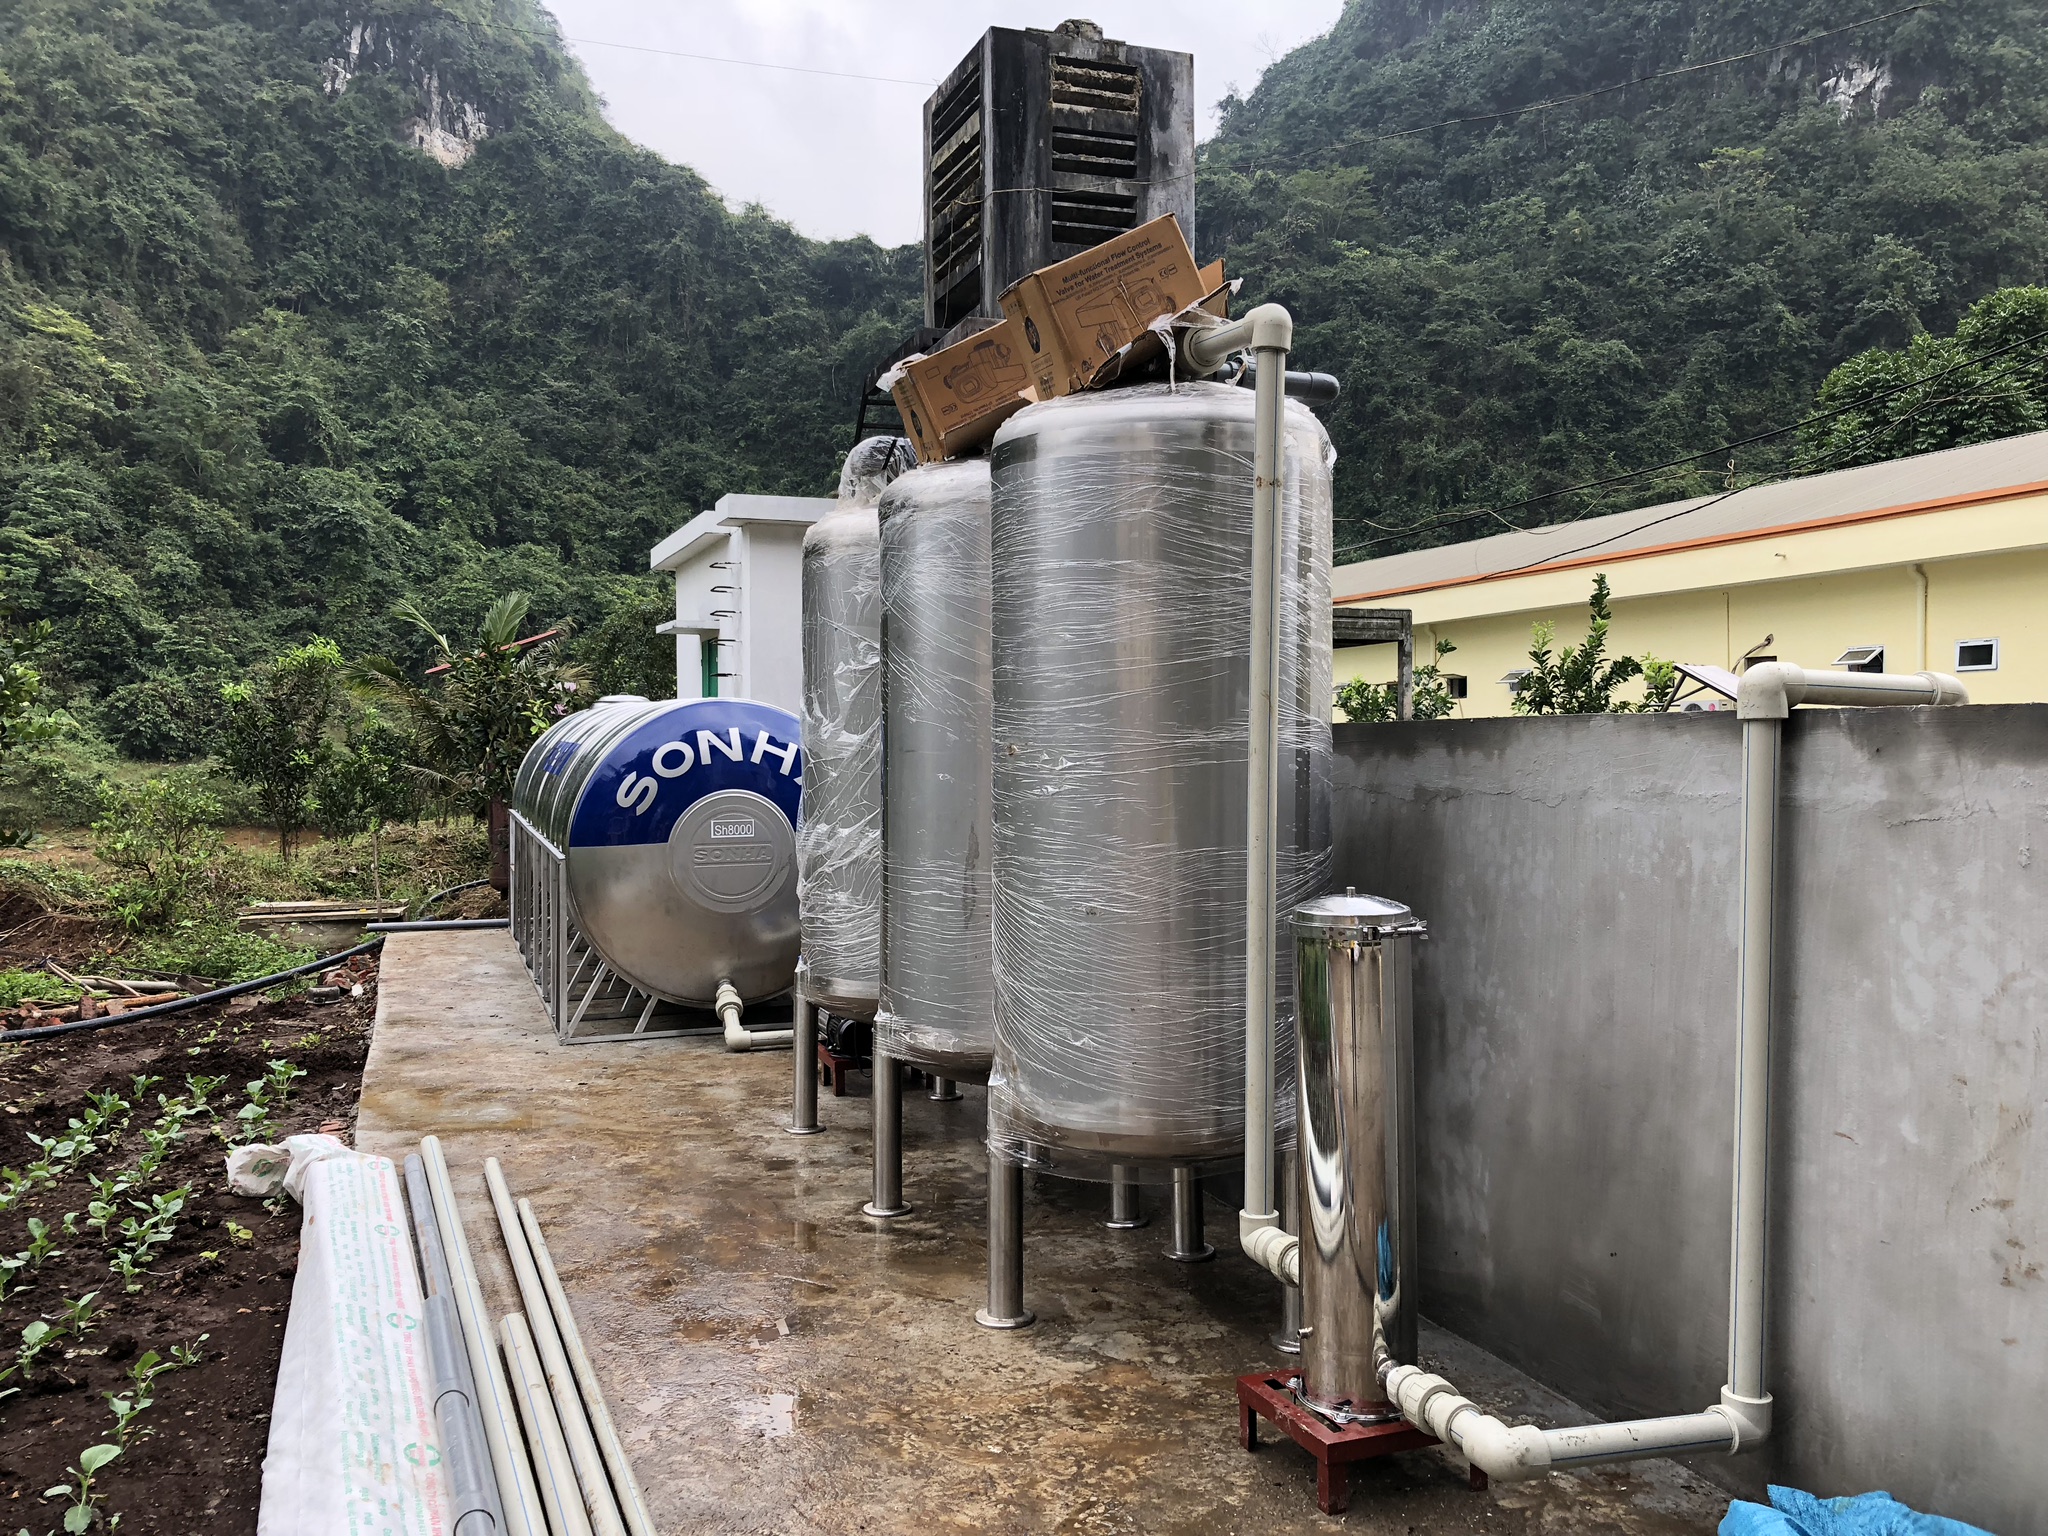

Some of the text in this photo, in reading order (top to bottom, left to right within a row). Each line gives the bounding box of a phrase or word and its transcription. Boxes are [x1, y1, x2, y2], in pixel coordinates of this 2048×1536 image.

[1056, 285, 1075, 296] Valve
[1074, 279, 1085, 290] for
[1084, 270, 1104, 284] Water
[1103, 256, 1135, 274] Treatment
[1135, 242, 1163, 262] Systems
[1061, 256, 1111, 285] Multi-functional
[1110, 249, 1127, 261] Flow
[1126, 237, 1150, 254] Control
[616, 727, 802, 816] SONH
[714, 824, 752, 836] Sh8000
[694, 848, 772, 862] SONHA
